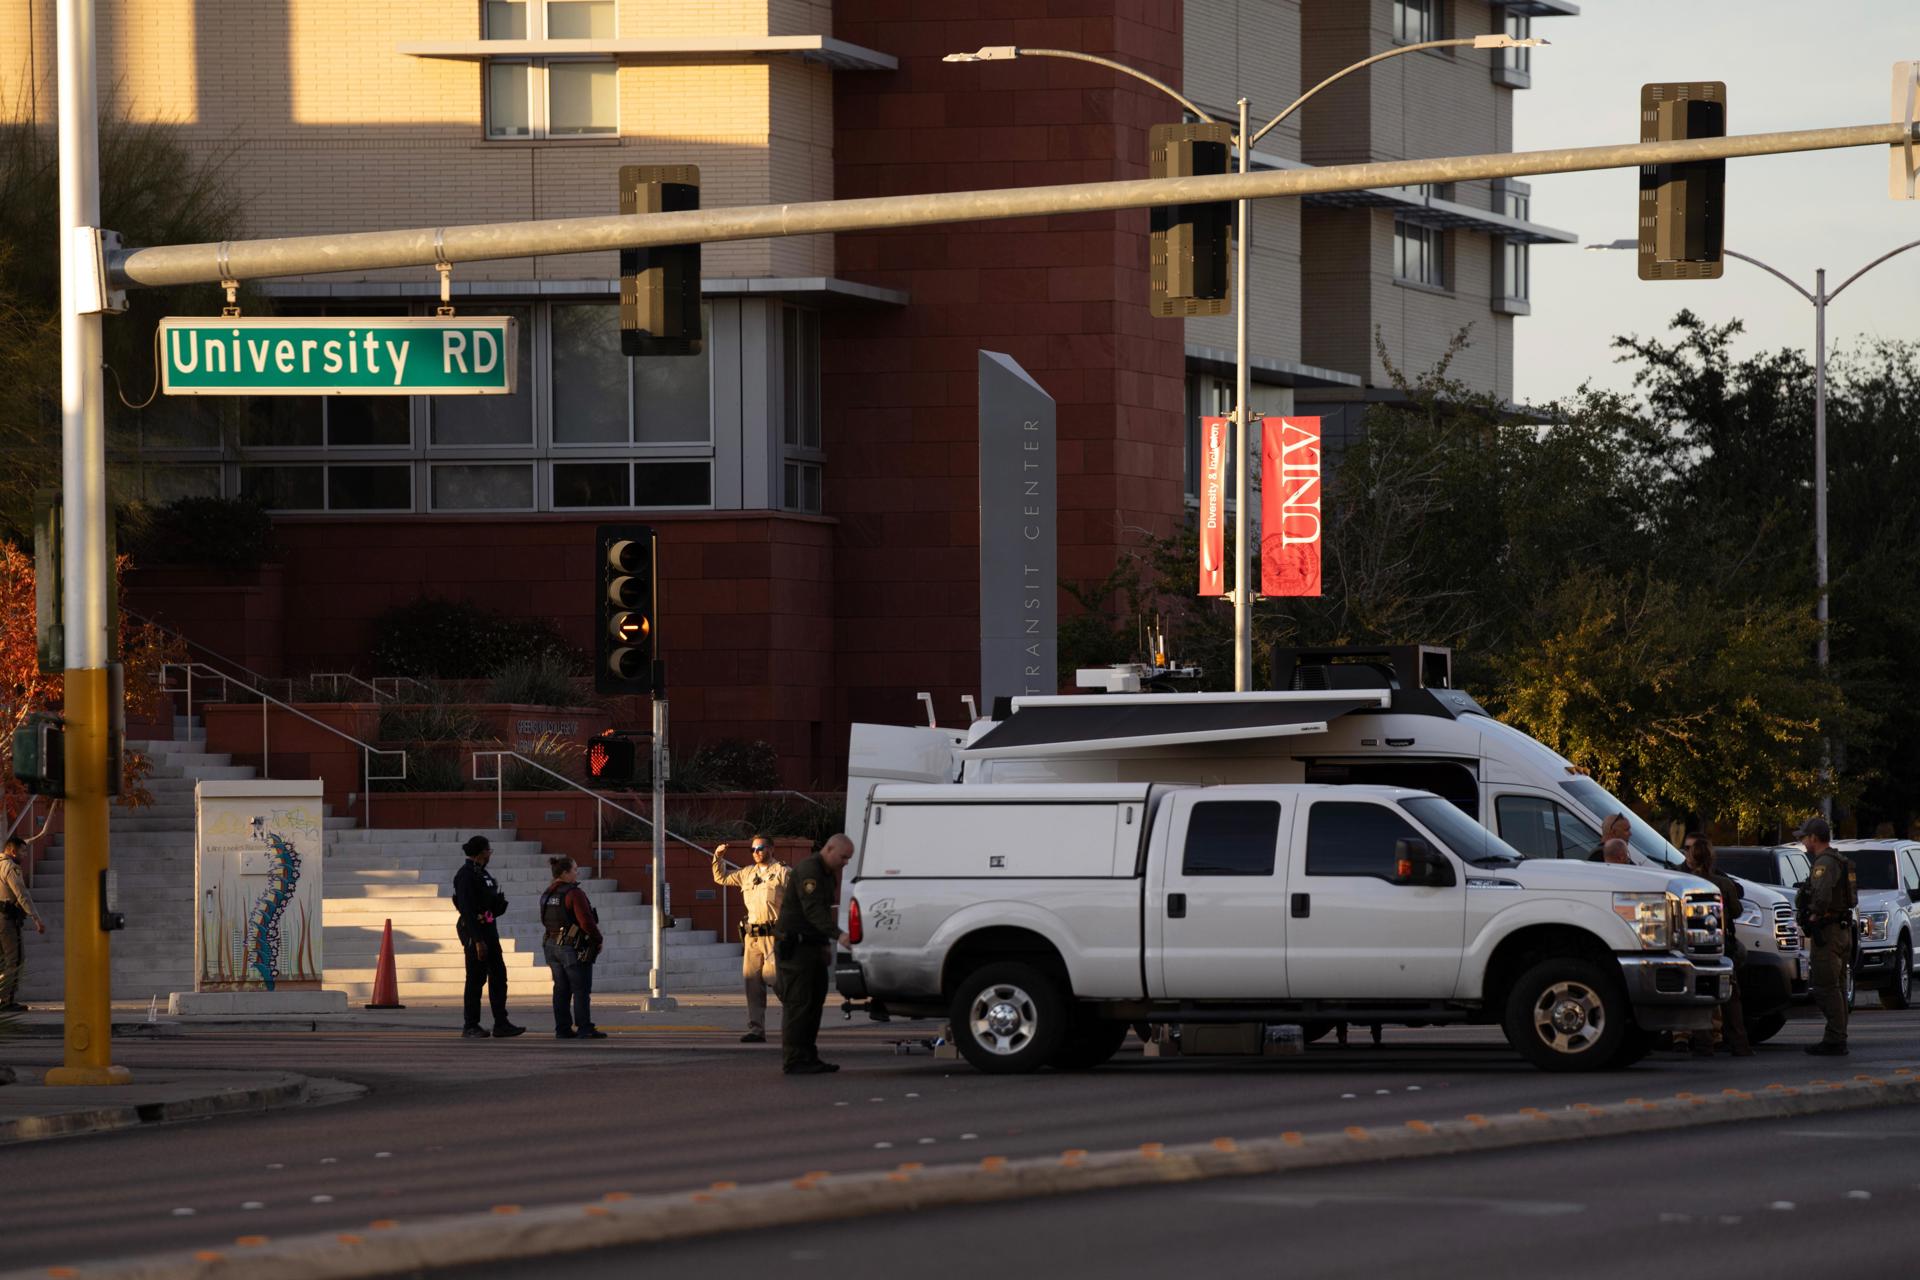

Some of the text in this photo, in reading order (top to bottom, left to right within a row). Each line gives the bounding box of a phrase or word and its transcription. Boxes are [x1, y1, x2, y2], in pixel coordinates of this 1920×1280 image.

[172, 329, 498, 385] University RD
[1207, 473, 1217, 481] &
[1281, 418, 1321, 550] UNLV
[1207, 482, 1219, 529] Diversity
[1024, 419, 1041, 696] TRANSIT CENTER
